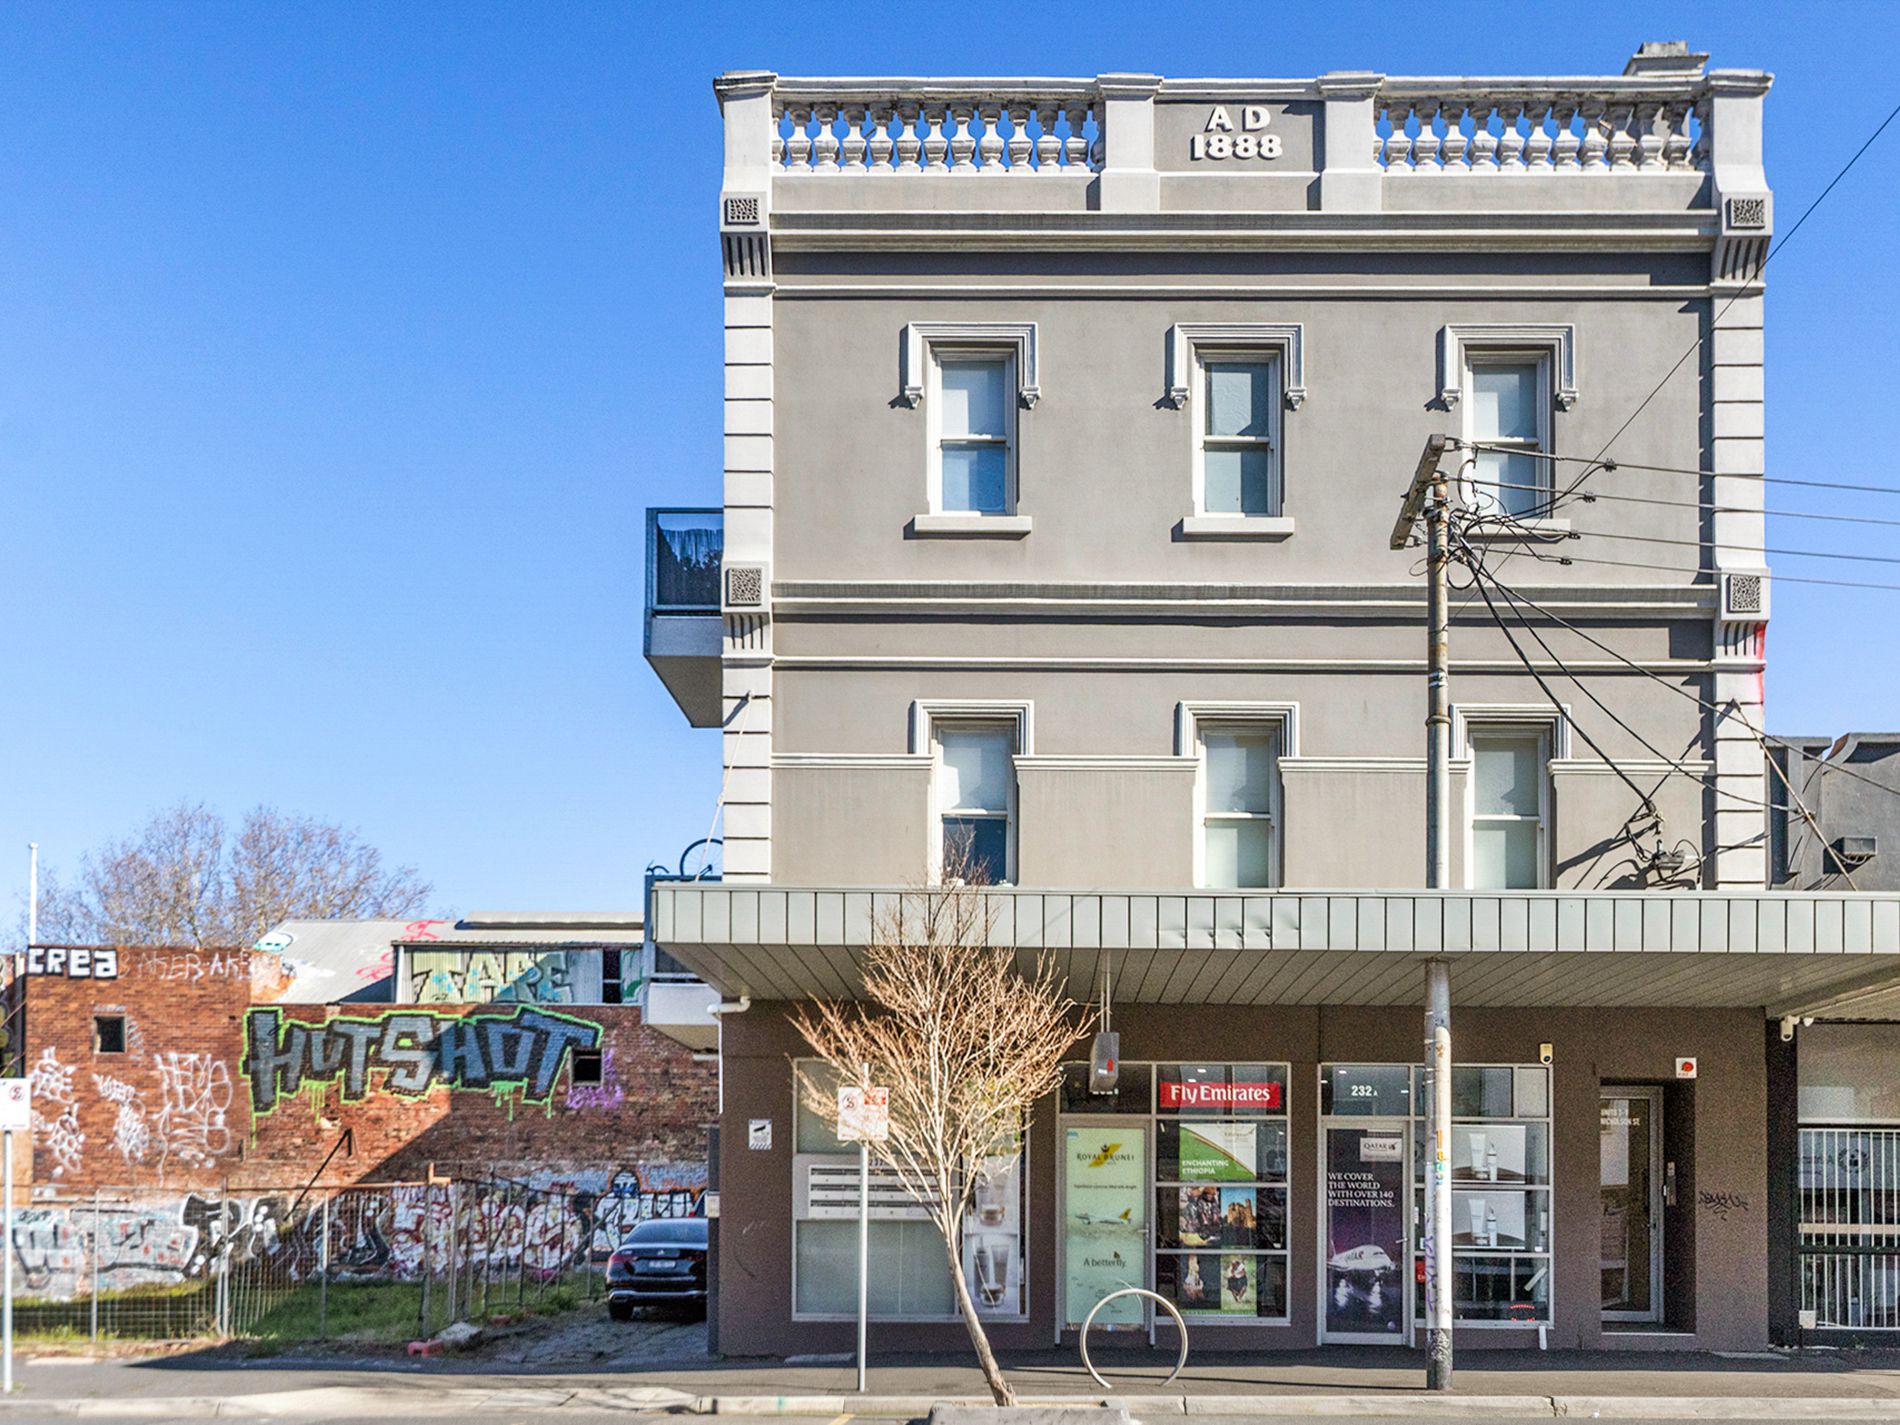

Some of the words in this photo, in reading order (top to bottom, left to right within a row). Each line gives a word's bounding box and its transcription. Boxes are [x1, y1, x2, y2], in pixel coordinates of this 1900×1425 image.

[1191, 134, 1283, 160] 1888
[1171, 1085, 1198, 1104] Fly
[1201, 1085, 1270, 1101] Emirates
[1363, 1142, 1387, 1150] QATAR
[1077, 1153, 1100, 1161] ROYAL
[1328, 1172, 1342, 1180] WE
[1343, 1172, 1374, 1181] COVER
[1328, 1181, 1346, 1189] THE
[1347, 1181, 1380, 1189] WORLD
[1328, 1190, 1352, 1198] WITH
[1353, 1190, 1378, 1198] OVER
[1379, 1190, 1394, 1198] 140
